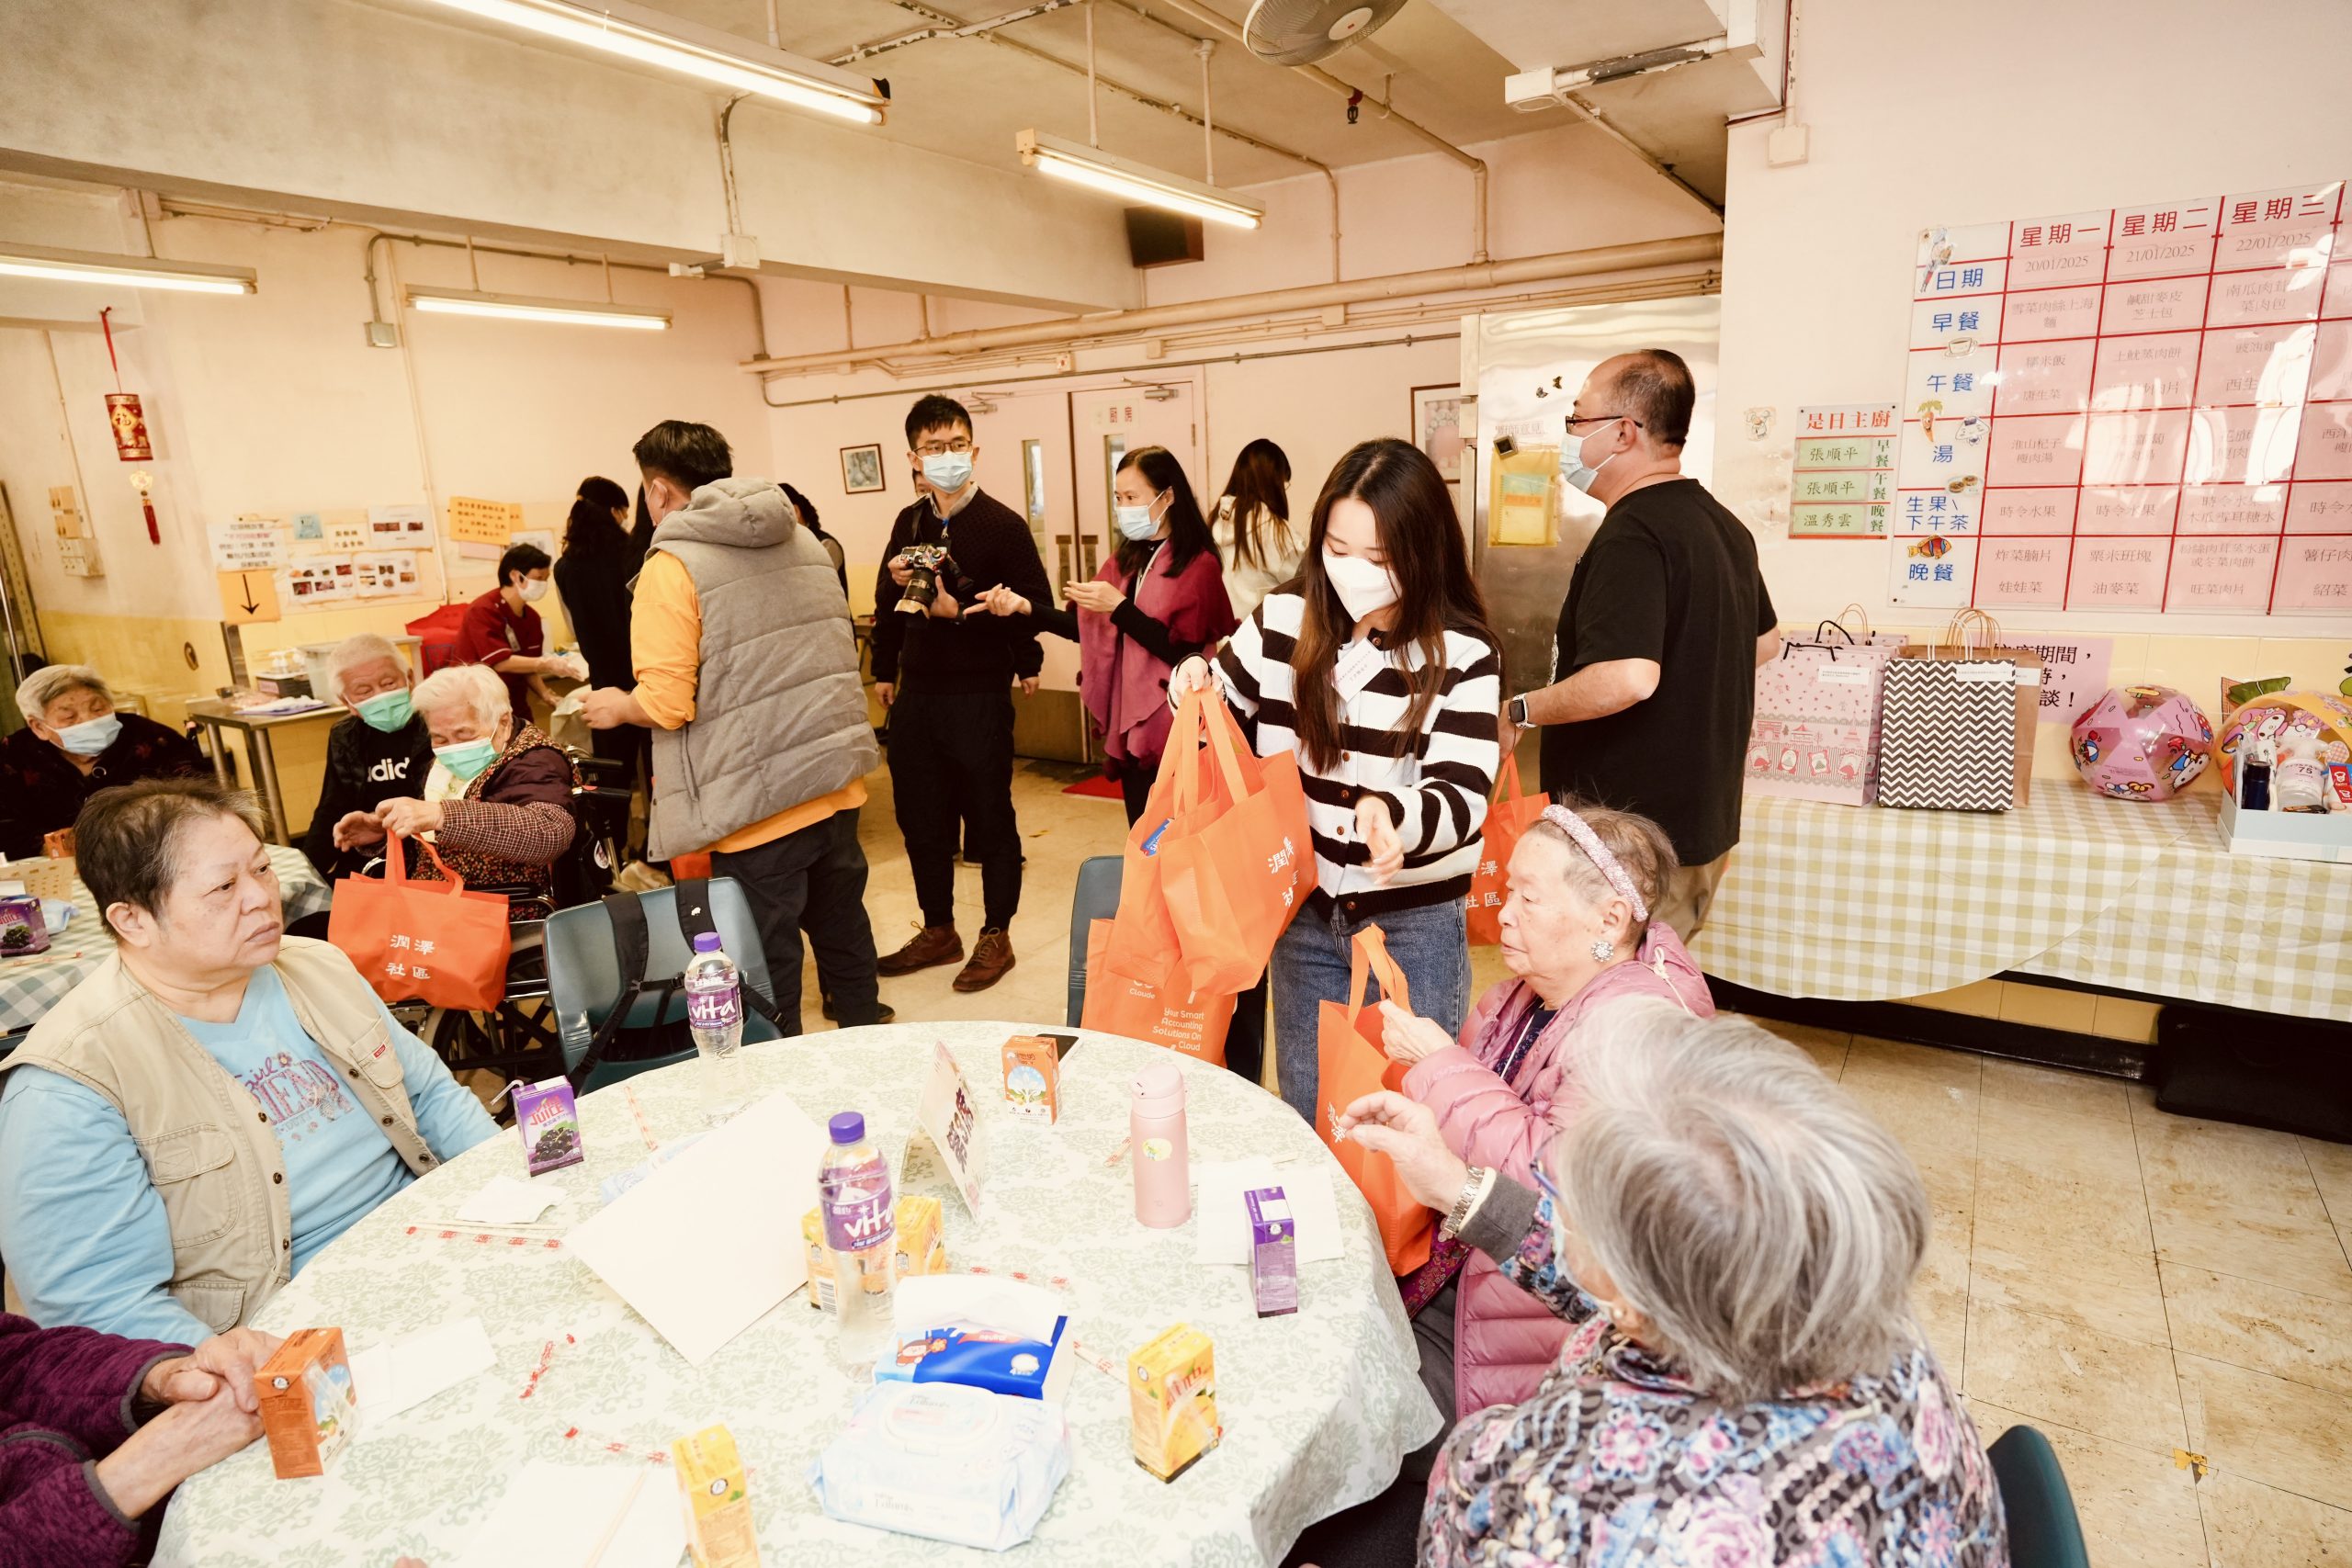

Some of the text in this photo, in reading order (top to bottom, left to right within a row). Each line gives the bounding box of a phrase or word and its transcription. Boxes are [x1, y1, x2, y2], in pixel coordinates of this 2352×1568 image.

[2231, 195, 2325, 225] 星期三
[2120, 208, 2209, 237] 星期二
[2019, 222, 2101, 248] 星期一
[2235, 231, 2312, 252] 22/01/2025
[2126, 243, 2196, 263] 21/01/2025
[2024, 255, 2089, 272] 20/01/2025
[1936, 267, 1984, 290] 日期
[1932, 311, 1979, 332] 早餐
[1927, 373, 1973, 393] 午餐
[1807, 410, 1891, 430] 是日主廚
[1810, 447, 1858, 461] 張順平
[1876, 439, 1889, 467] 早餐
[1932, 445, 1953, 463] 湯
[1807, 480, 1855, 494] 張順平
[1873, 472, 1888, 501] 午餐
[1804, 513, 1852, 527] 溫秀雲
[1871, 505, 1885, 533] 晚餐
[1999, 504, 2057, 518] 時令水果
[1905, 514, 1969, 531] 下午茶
[1908, 563, 1954, 581] 晚餐
[1998, 581, 2043, 594] 娃娃菜
[2092, 581, 2140, 595] 油麥菜
[2299, 766, 2313, 774] 75
[390, 934, 435, 955] 潤澤
[385, 962, 431, 979] 社區
[1164, 1007, 1204, 1020] Your Smart
[1152, 1025, 1202, 1042] Solutions On
[1161, 1017, 1203, 1032] Accounting
[1178, 1041, 1201, 1051] Cloud
